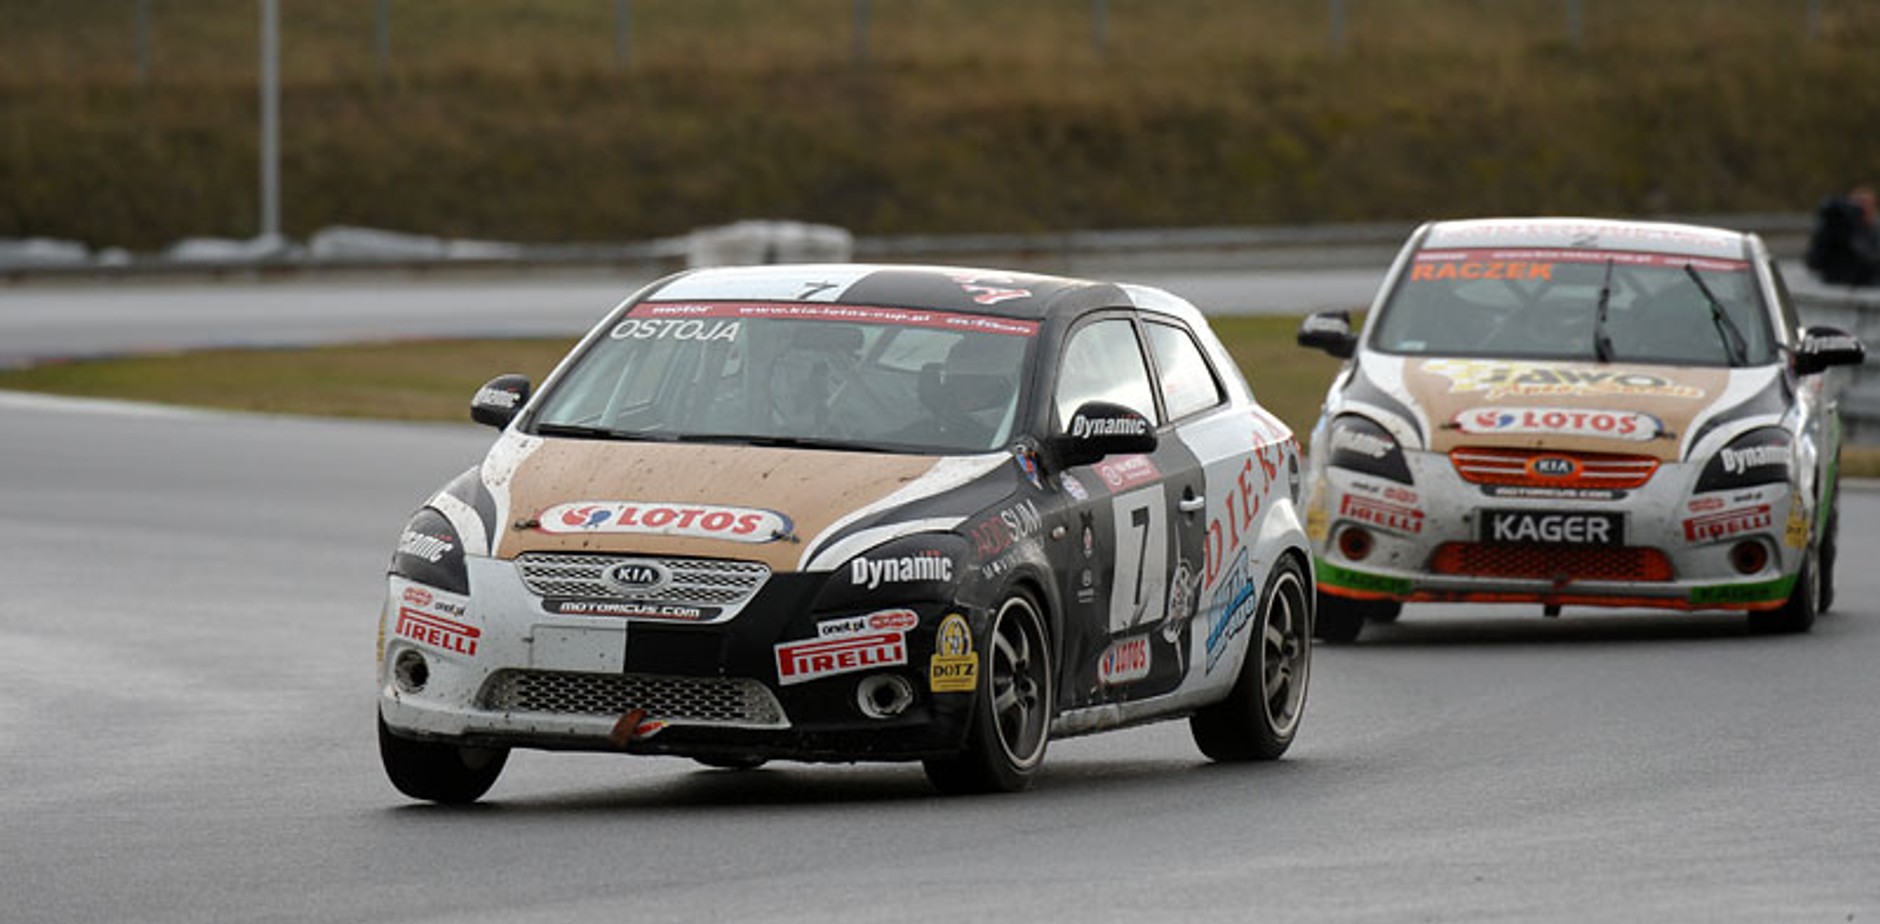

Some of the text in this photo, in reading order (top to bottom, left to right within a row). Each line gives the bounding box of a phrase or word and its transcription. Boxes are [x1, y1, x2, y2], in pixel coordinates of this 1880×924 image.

[1410, 261, 1553, 282] RACZEK
[610, 319, 741, 342] OSTOJA
[1072, 414, 1147, 439] Dynamic
[1522, 411, 1637, 434] LOTOS
[1539, 460, 1569, 472] KIA
[616, 507, 762, 535] LOTOS
[1340, 493, 1425, 534] PIRELLI
[1682, 503, 1771, 542] PIRELLI
[1493, 514, 1610, 543] KAGER
[1130, 505, 1150, 606] 7
[616, 567, 653, 583] KIA
[851, 555, 952, 589] Dynamic
[395, 606, 481, 657] PIRELLI
[821, 620, 866, 636] onet.pl
[777, 632, 904, 677] PIRELLI
[1115, 639, 1147, 674] LOTOS
[933, 663, 974, 678] DOTZ
